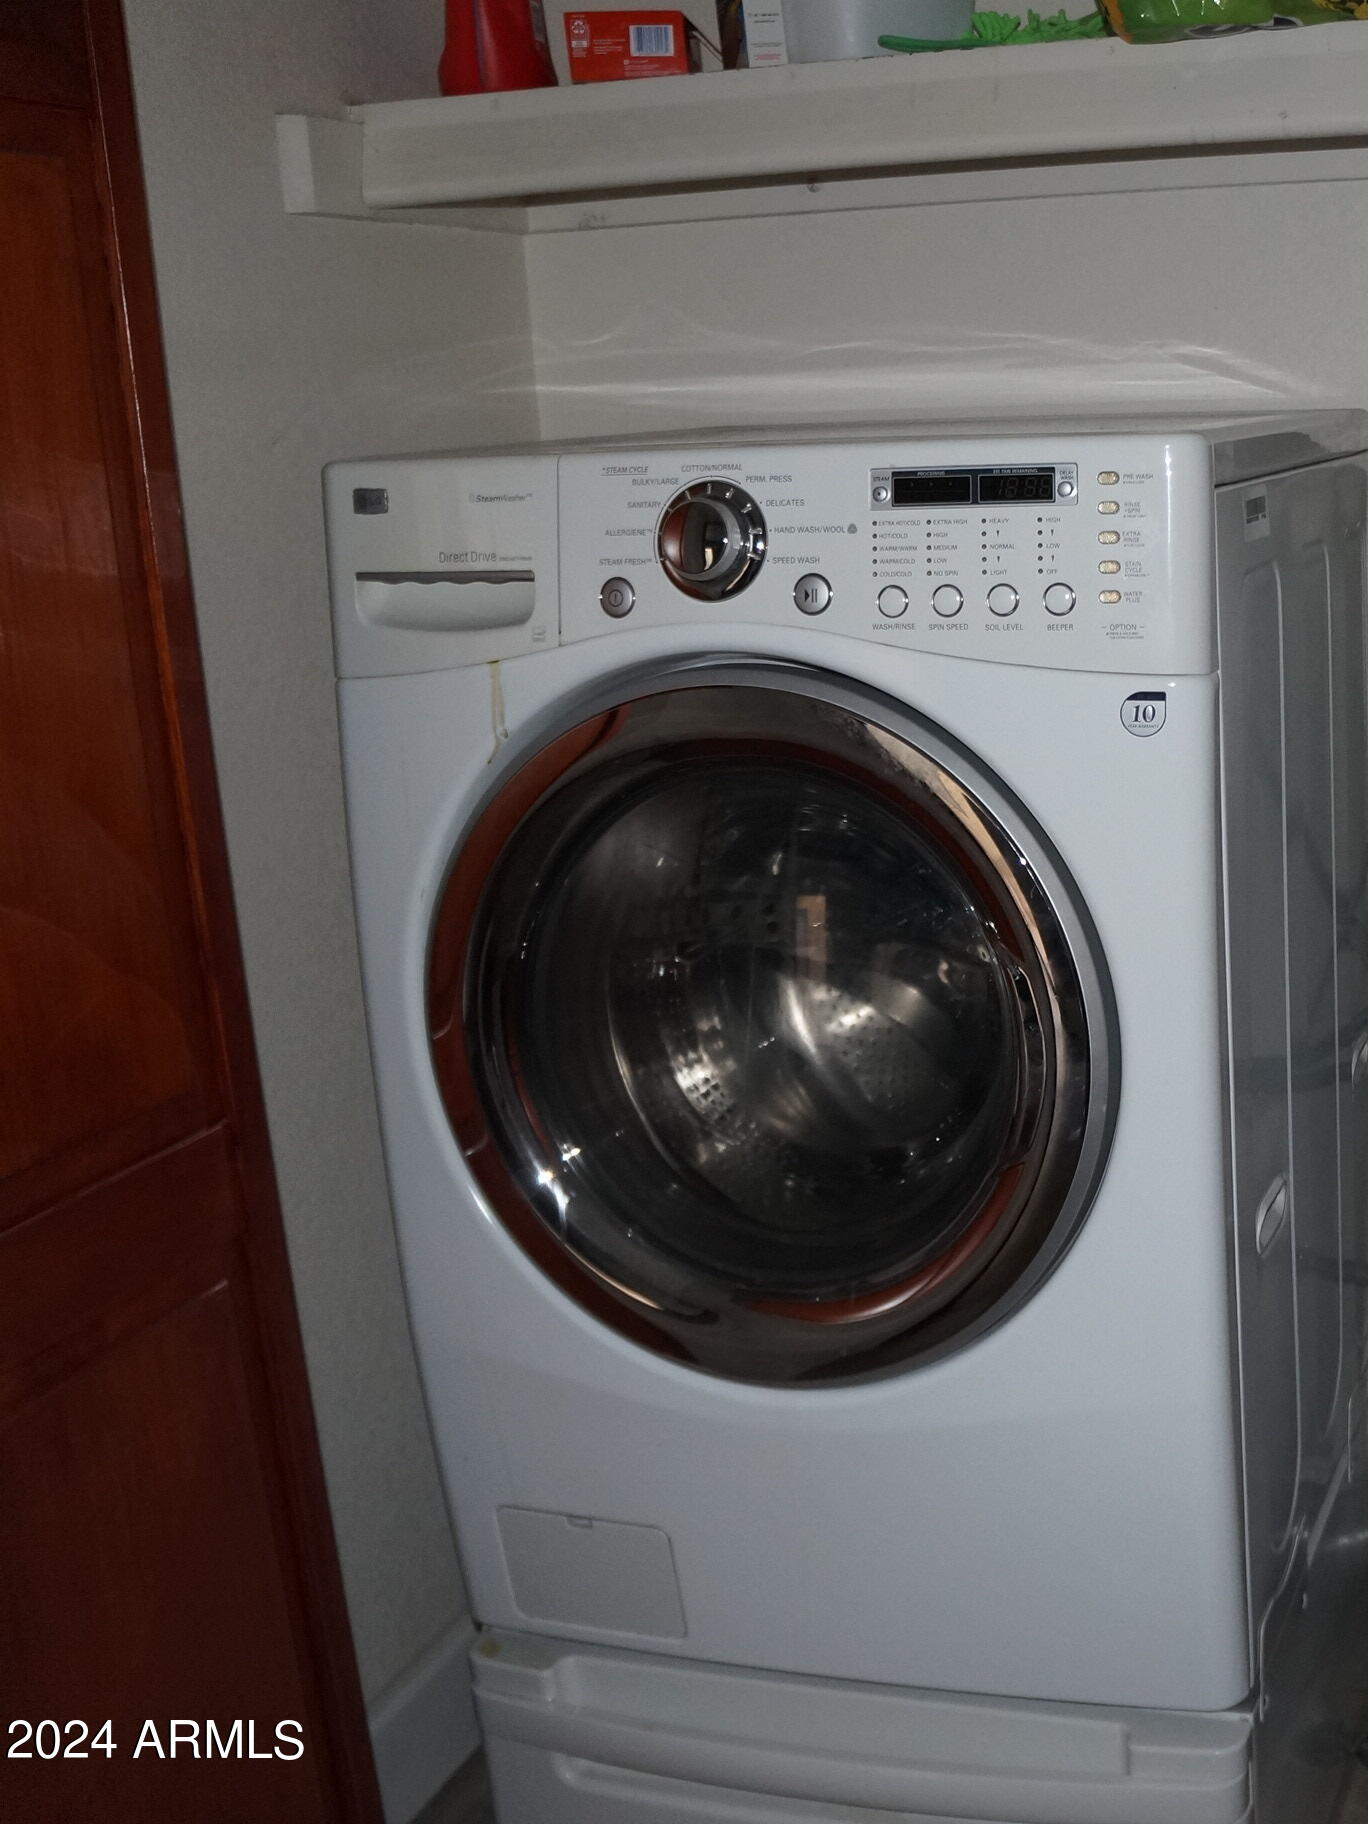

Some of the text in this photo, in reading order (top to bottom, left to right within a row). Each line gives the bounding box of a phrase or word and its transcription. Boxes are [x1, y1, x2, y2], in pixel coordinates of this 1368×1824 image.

[682, 464, 742, 472] COTTON/NORMAL
[632, 478, 680, 486] BULKY/LARGE
[774, 526, 846, 534] HAND WASH/WOOL
[439, 551, 468, 564] Direct
[470, 551, 497, 562] Drive
[600, 558, 622, 566] STEAM
[1047, 624, 1074, 632] BEEPER
[1110, 624, 1137, 632] OPTION
[1132, 704, 1156, 722] 10
